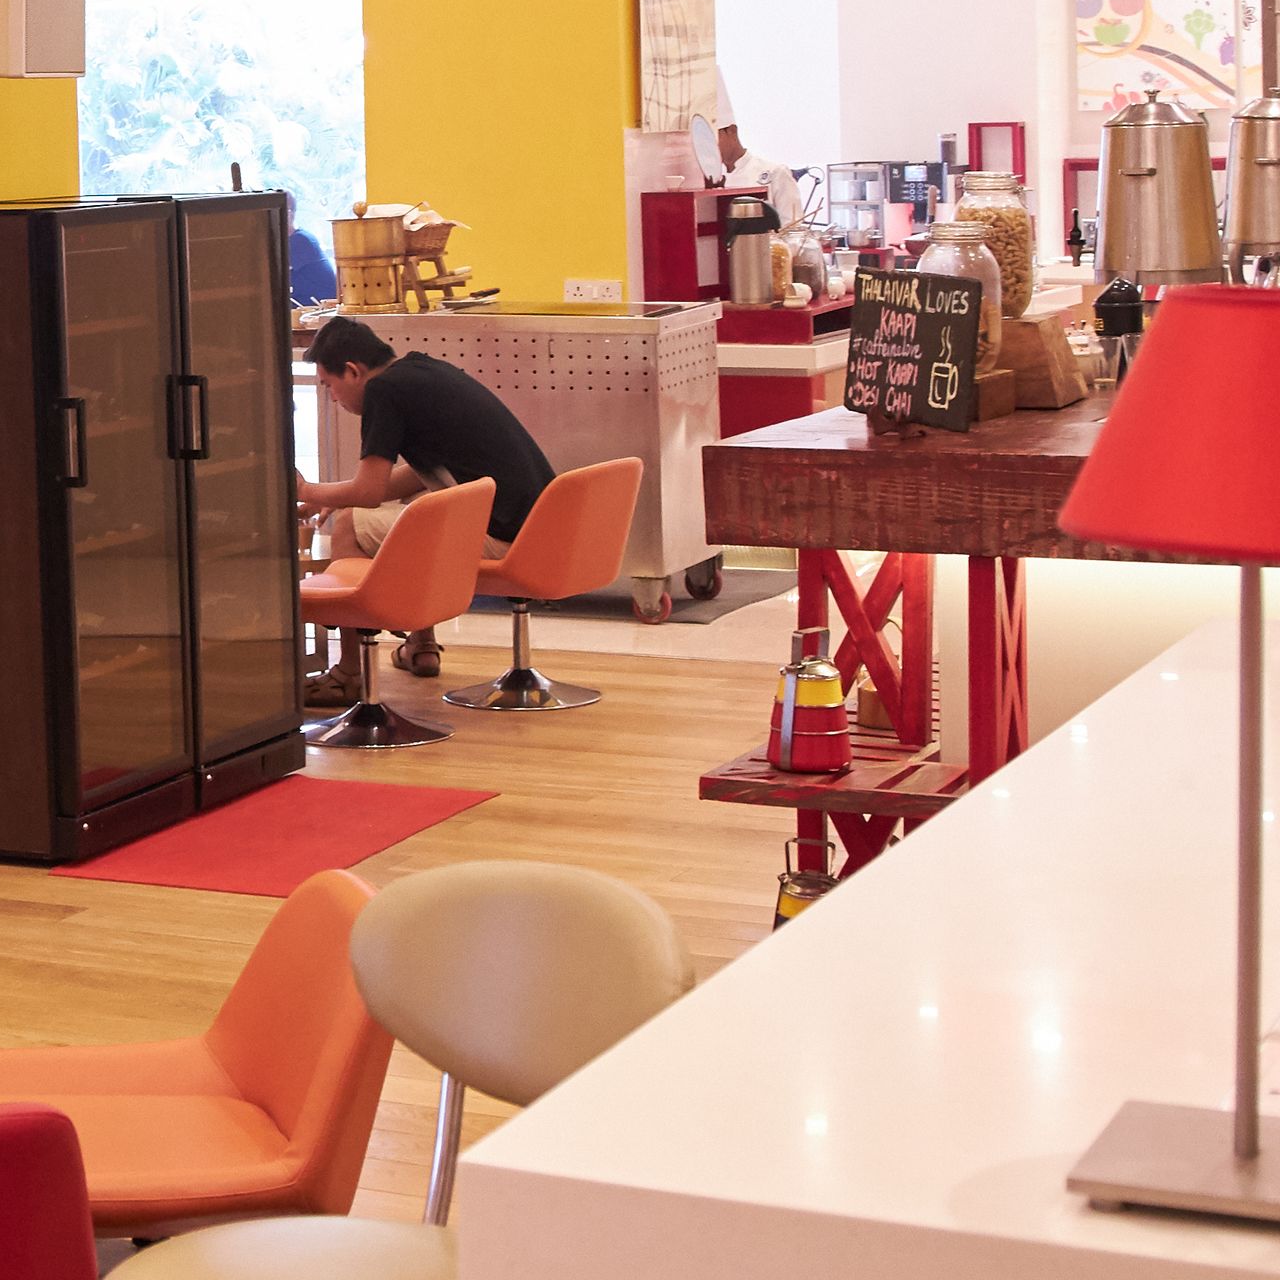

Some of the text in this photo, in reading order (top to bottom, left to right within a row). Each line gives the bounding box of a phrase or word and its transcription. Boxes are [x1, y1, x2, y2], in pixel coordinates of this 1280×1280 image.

[858, 274, 969, 314] THALAIVAR LOVES
[880, 307, 917, 340] KAAPI
[856, 358, 918, 386] HOT KAAPI
[885, 386, 911, 416] CHAI
